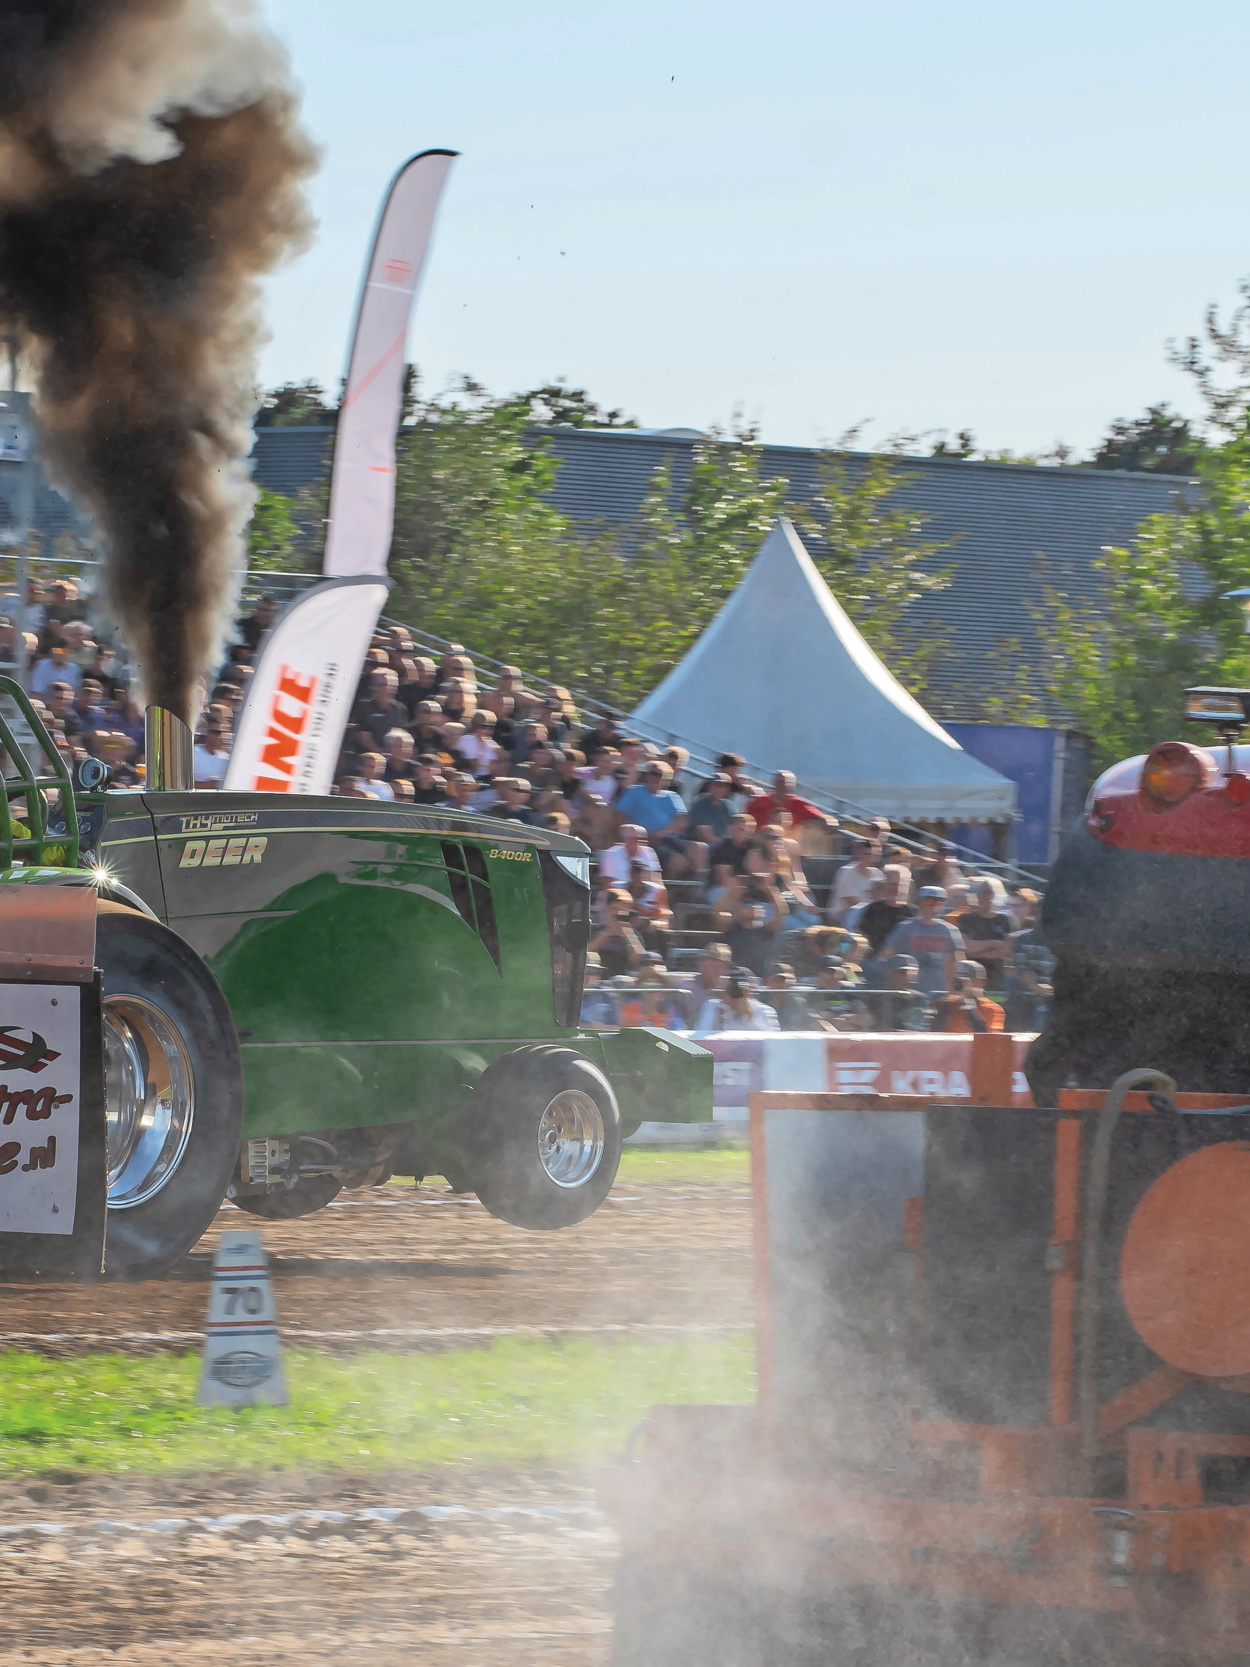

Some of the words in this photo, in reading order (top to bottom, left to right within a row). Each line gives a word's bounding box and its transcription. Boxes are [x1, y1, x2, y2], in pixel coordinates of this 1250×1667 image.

[179, 837, 268, 868] DEER
[489, 849, 532, 862] 8400R
[221, 1286, 264, 1315] 70
